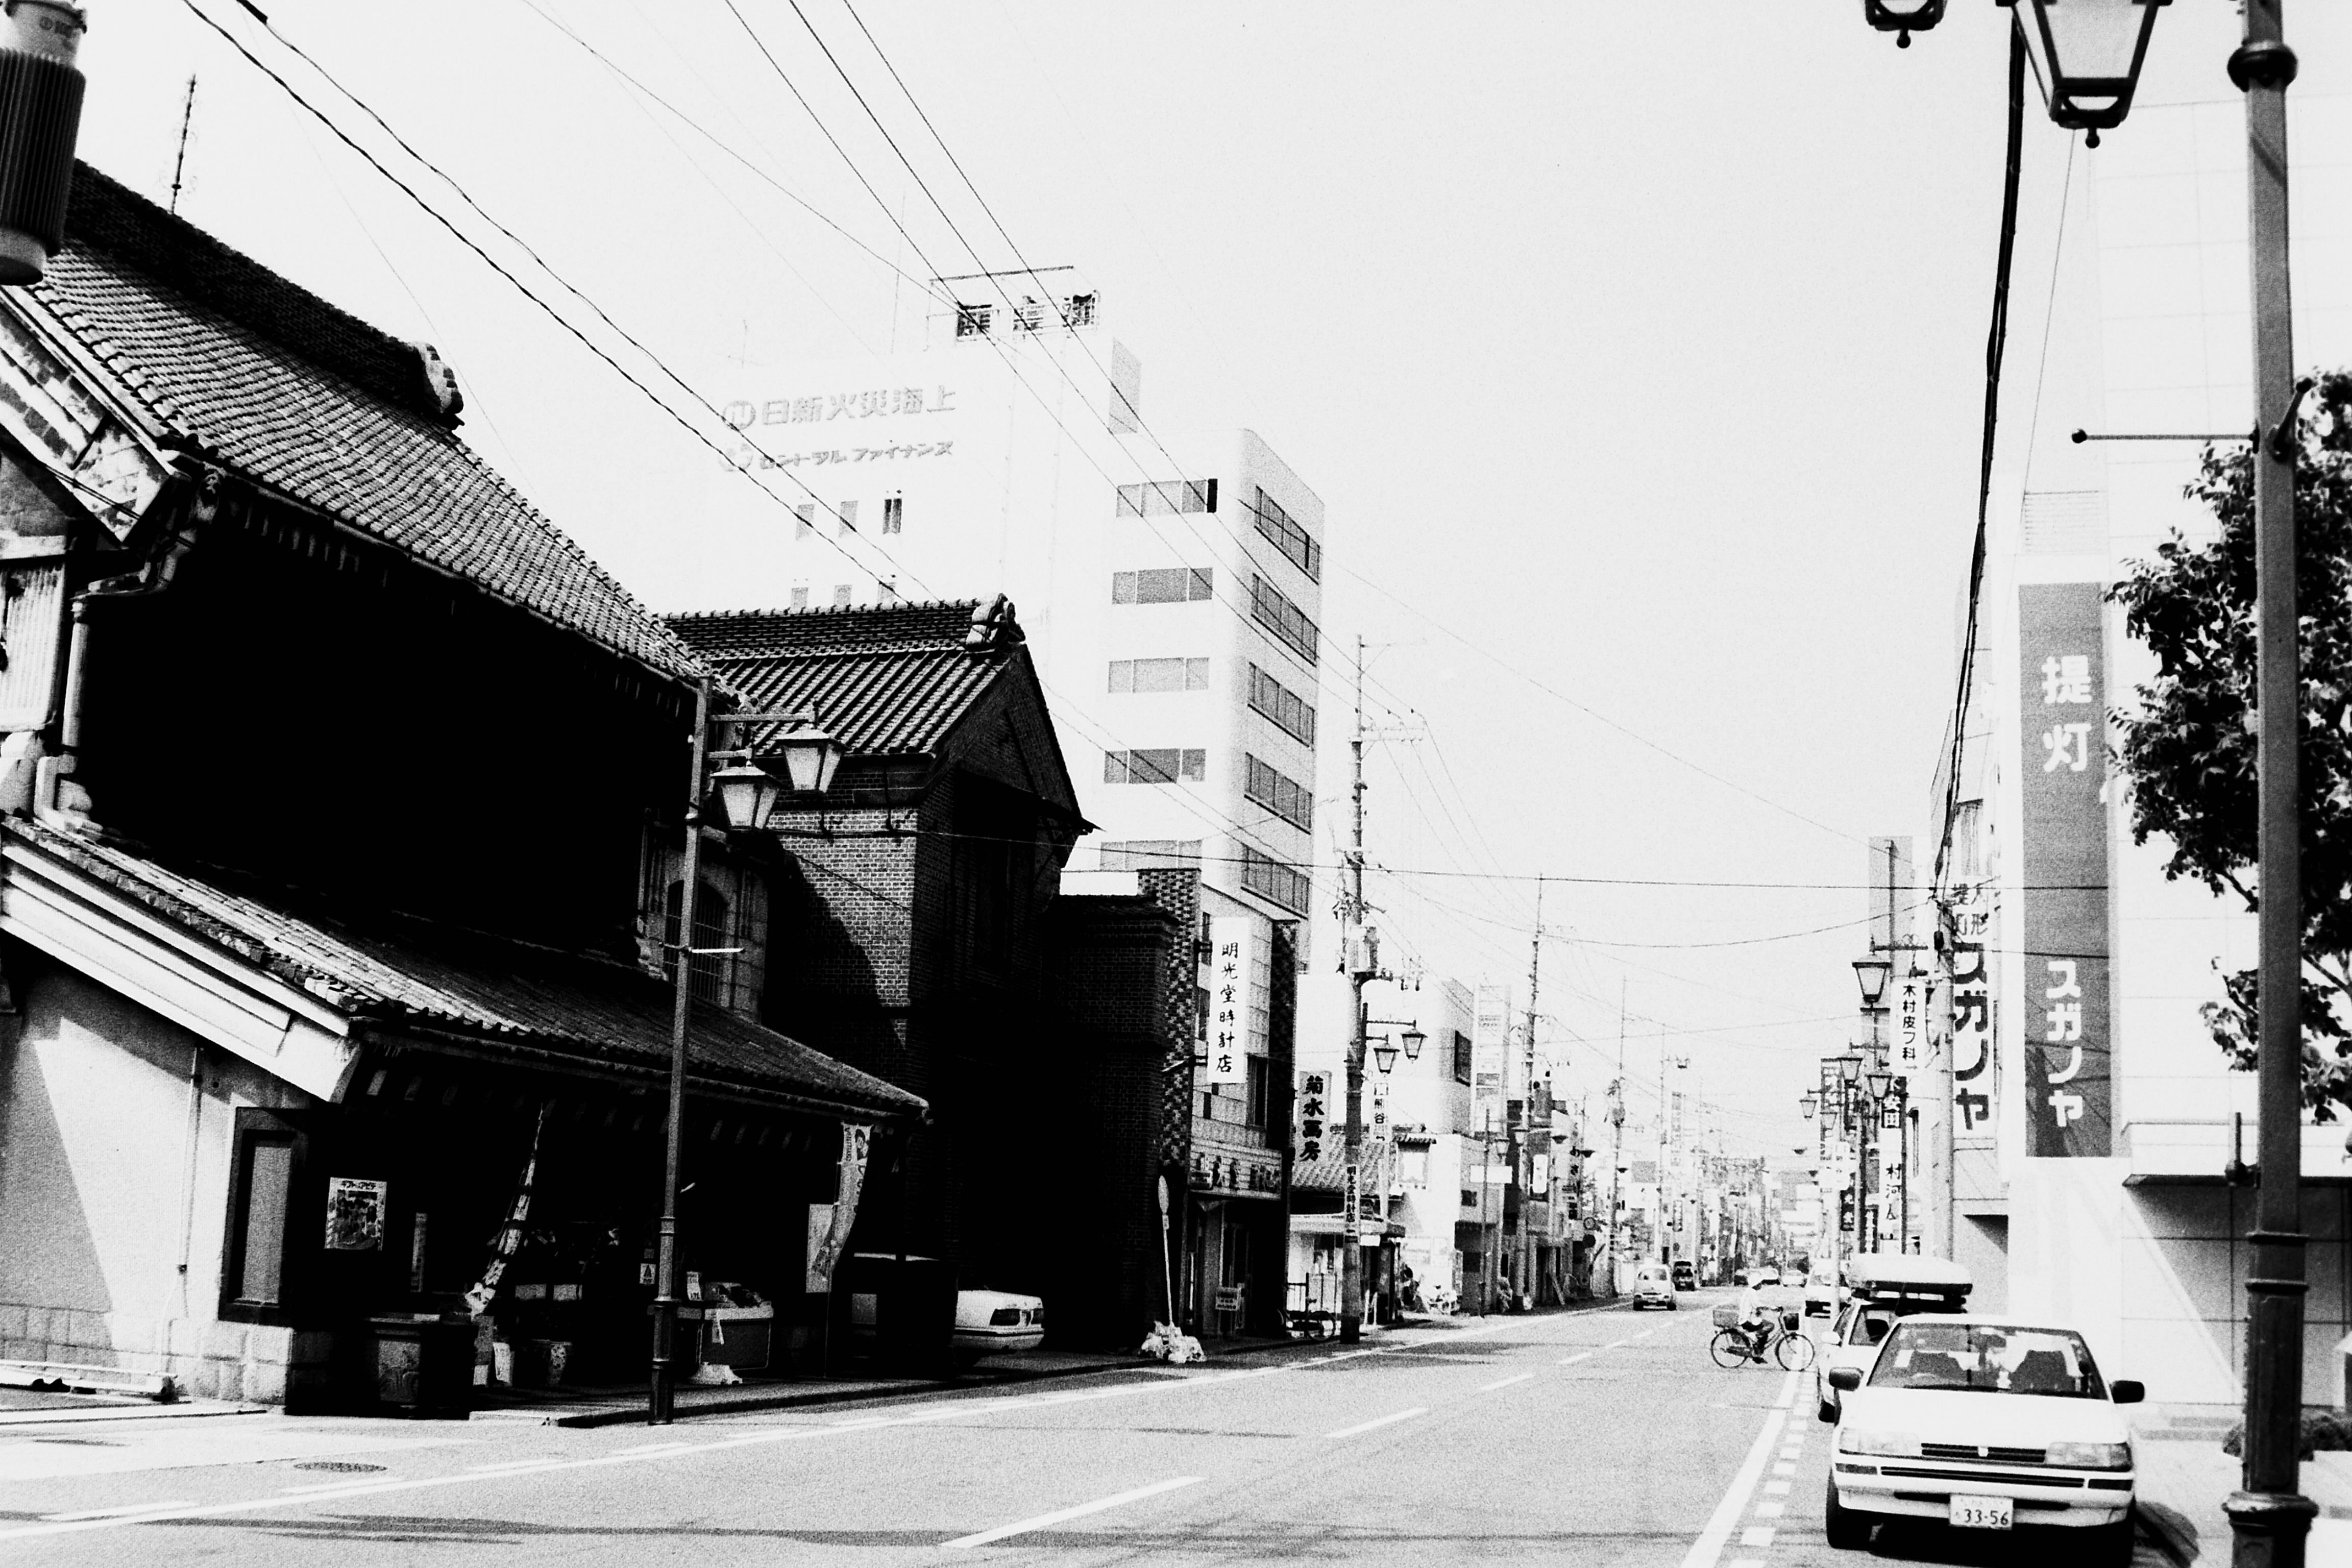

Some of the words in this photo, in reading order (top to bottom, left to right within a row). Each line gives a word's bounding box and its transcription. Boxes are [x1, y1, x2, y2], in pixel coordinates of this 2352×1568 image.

[762, 385, 956, 426] 日新火災海上
[2042, 654, 2092, 772] 提灯
[1215, 941, 1239, 1074] 明光堂時計店
[1902, 985, 1916, 1061] 木村皮フ科
[1954, 942, 1989, 1130] スガノヤ
[2046, 961, 2083, 1126] スガノヤ
[1299, 1075, 1325, 1162] 菊水画房
